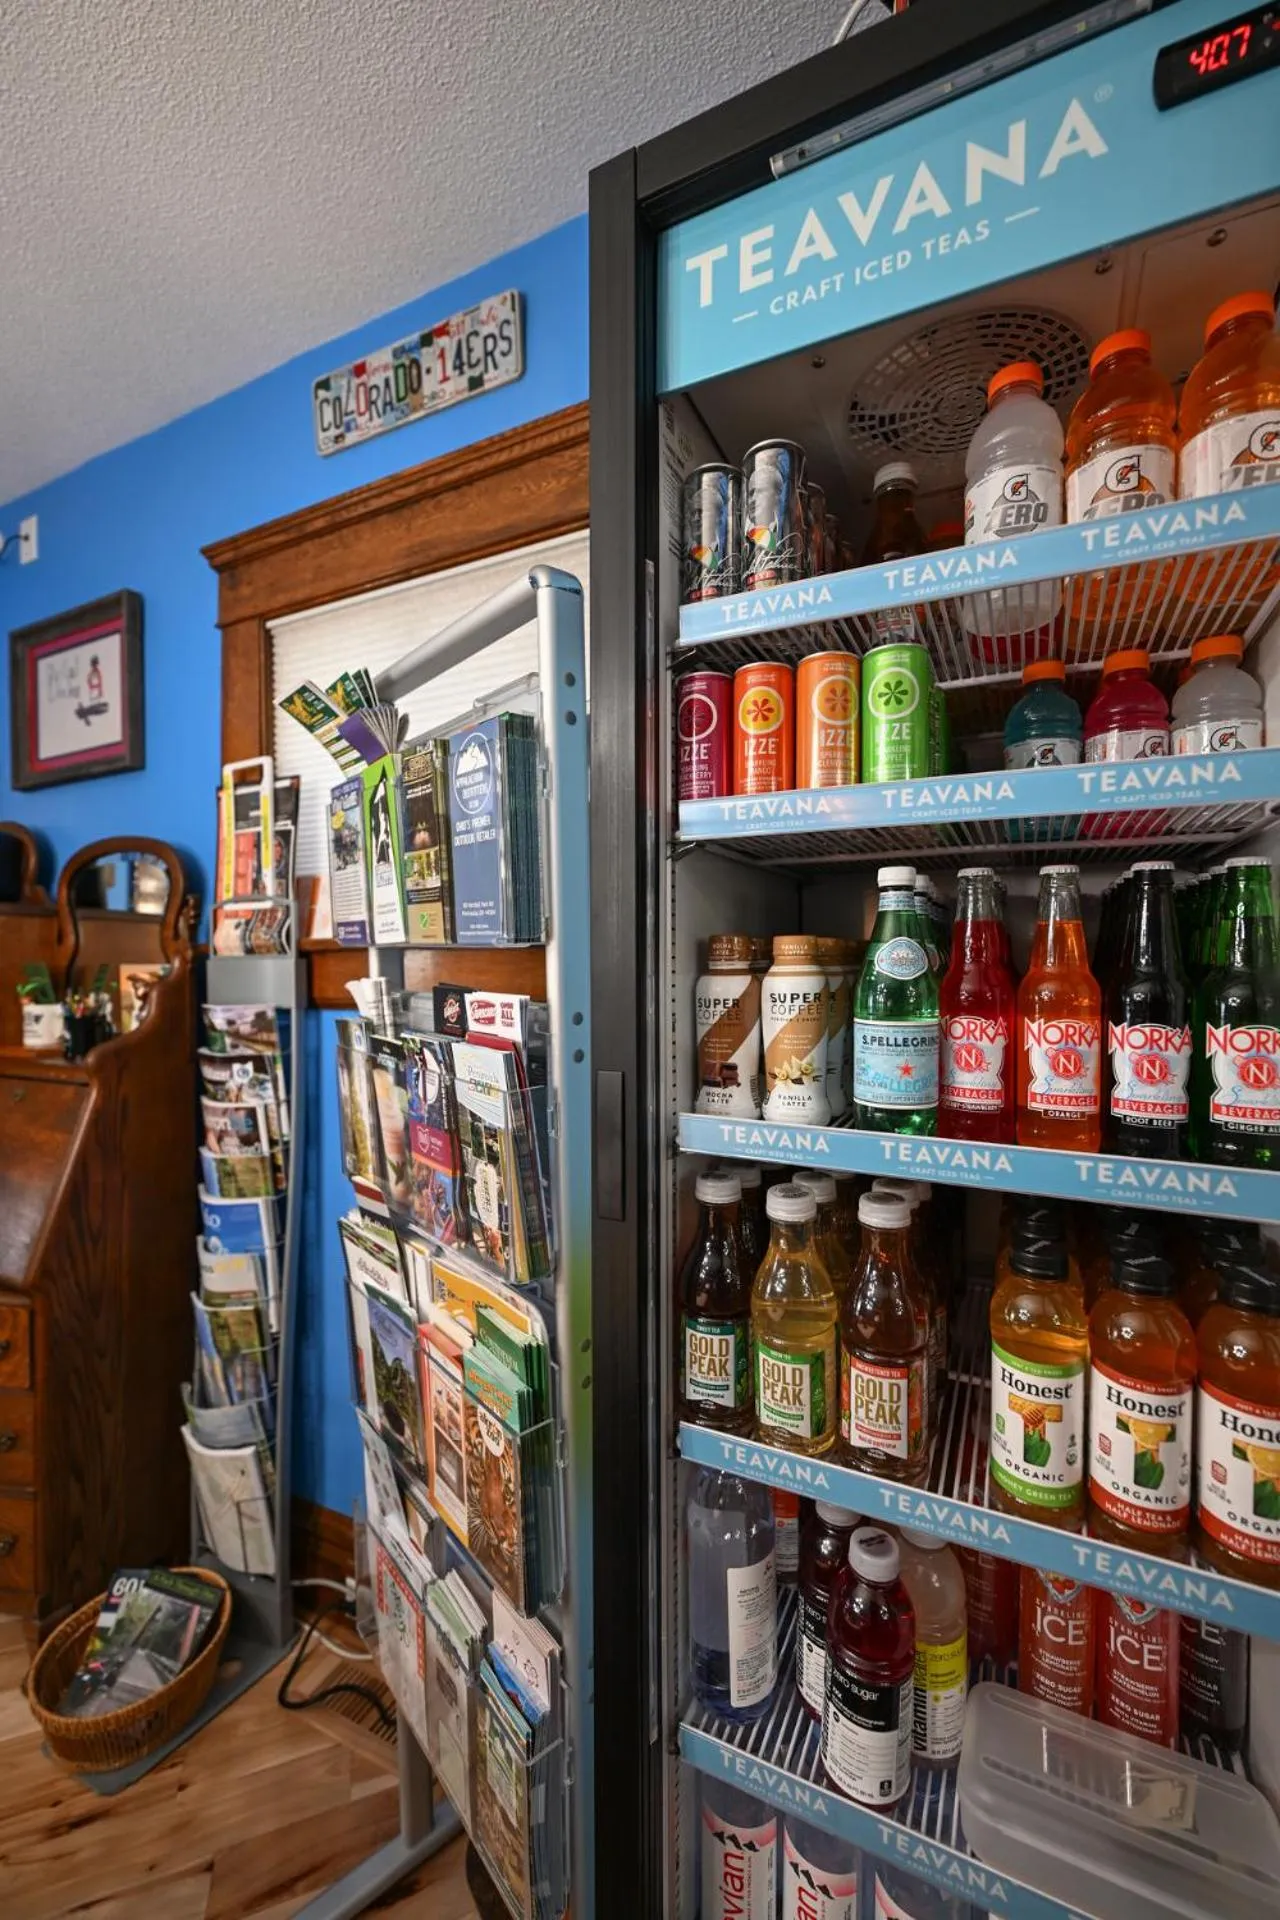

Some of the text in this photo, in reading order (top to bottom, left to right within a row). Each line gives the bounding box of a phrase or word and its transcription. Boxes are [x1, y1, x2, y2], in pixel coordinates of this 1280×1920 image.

[685, 97, 1109, 308] TEAVANA
[769, 220, 990, 316] CRAFT ICED TEAS
[319, 318, 513, 432] COLORADO 14ERS
[1081, 500, 1246, 550] TEAVANA
[884, 547, 1018, 590] TEAVANA
[721, 585, 832, 623] TEAVANA
[680, 743, 711, 763] IZZE
[744, 738, 777, 757] IZZE
[1077, 761, 1241, 793] TEAVANA
[882, 780, 1015, 808] TEAVANA
[1114, 789, 1202, 804] CRAFT ICED TEAS
[719, 796, 832, 821] TEAVANA
[475, 829, 497, 843] RETAILER
[697, 997, 741, 1009] SUPER
[770, 993, 821, 1004] SUPER
[770, 1004, 824, 1016] COFFEE
[697, 1009, 742, 1021] COFFEE
[941, 1016, 1008, 1045] NORKA
[1025, 1018, 1100, 1048] NORKA
[1108, 1022, 1193, 1054] NORKA
[1059, 1054, 1075, 1074] N
[1142, 1060, 1160, 1080] N
[1249, 1063, 1269, 1084] N
[944, 1087, 998, 1099] BEVERAGES
[1036, 1095, 1095, 1106] BEVERAGES
[1048, 1110, 1081, 1118] ORANGE
[1118, 1100, 1184, 1114] BEVERAGES
[1126, 1115, 1173, 1127] ROOT BEER
[1227, 1122, 1265, 1132] GINGER
[719, 1125, 830, 1153] TEAVANA
[880, 1140, 1013, 1173] TEAVANA
[1075, 1160, 1238, 1197] TEAVANA
[1111, 1189, 1198, 1205] CRAFT ICED TEAS
[689, 1333, 730, 1357] GOLD
[689, 1352, 730, 1376] PEAK
[762, 1358, 804, 1386] GOLD
[762, 1376, 803, 1406] PEAK
[854, 1374, 901, 1404] GOLD
[1000, 1367, 1072, 1399] Honest
[854, 1395, 901, 1425] PEAK
[1105, 1384, 1183, 1418] Honest
[720, 1441, 830, 1490] TEAVANA
[1005, 1458, 1064, 1482] ORGANIC
[1026, 1487, 1056, 1501] GREEN
[1111, 1481, 1178, 1505] ORGANIC
[879, 1488, 1012, 1544] TEAVANA
[1105, 1501, 1181, 1529] HALF LEMONADE
[1116, 1501, 1143, 1517] HALF
[1146, 1510, 1164, 1522] TEA
[1219, 1533, 1246, 1551] HALF
[1233, 1533, 1263, 1550] HALF
[1073, 1544, 1235, 1611] TEAVANA
[1035, 1606, 1086, 1646] ICE
[1109, 1625, 1164, 1672] ICE
[850, 1684, 880, 1702] sugar
[1035, 1672, 1083, 1694] ZERO SUGAR
[1112, 1669, 1160, 1692] STRAWBERRY
[1110, 1694, 1161, 1721] ZERO SUGAR
[720, 1749, 828, 1816] TEAVANA
[878, 1822, 1008, 1904] TEAVANA
